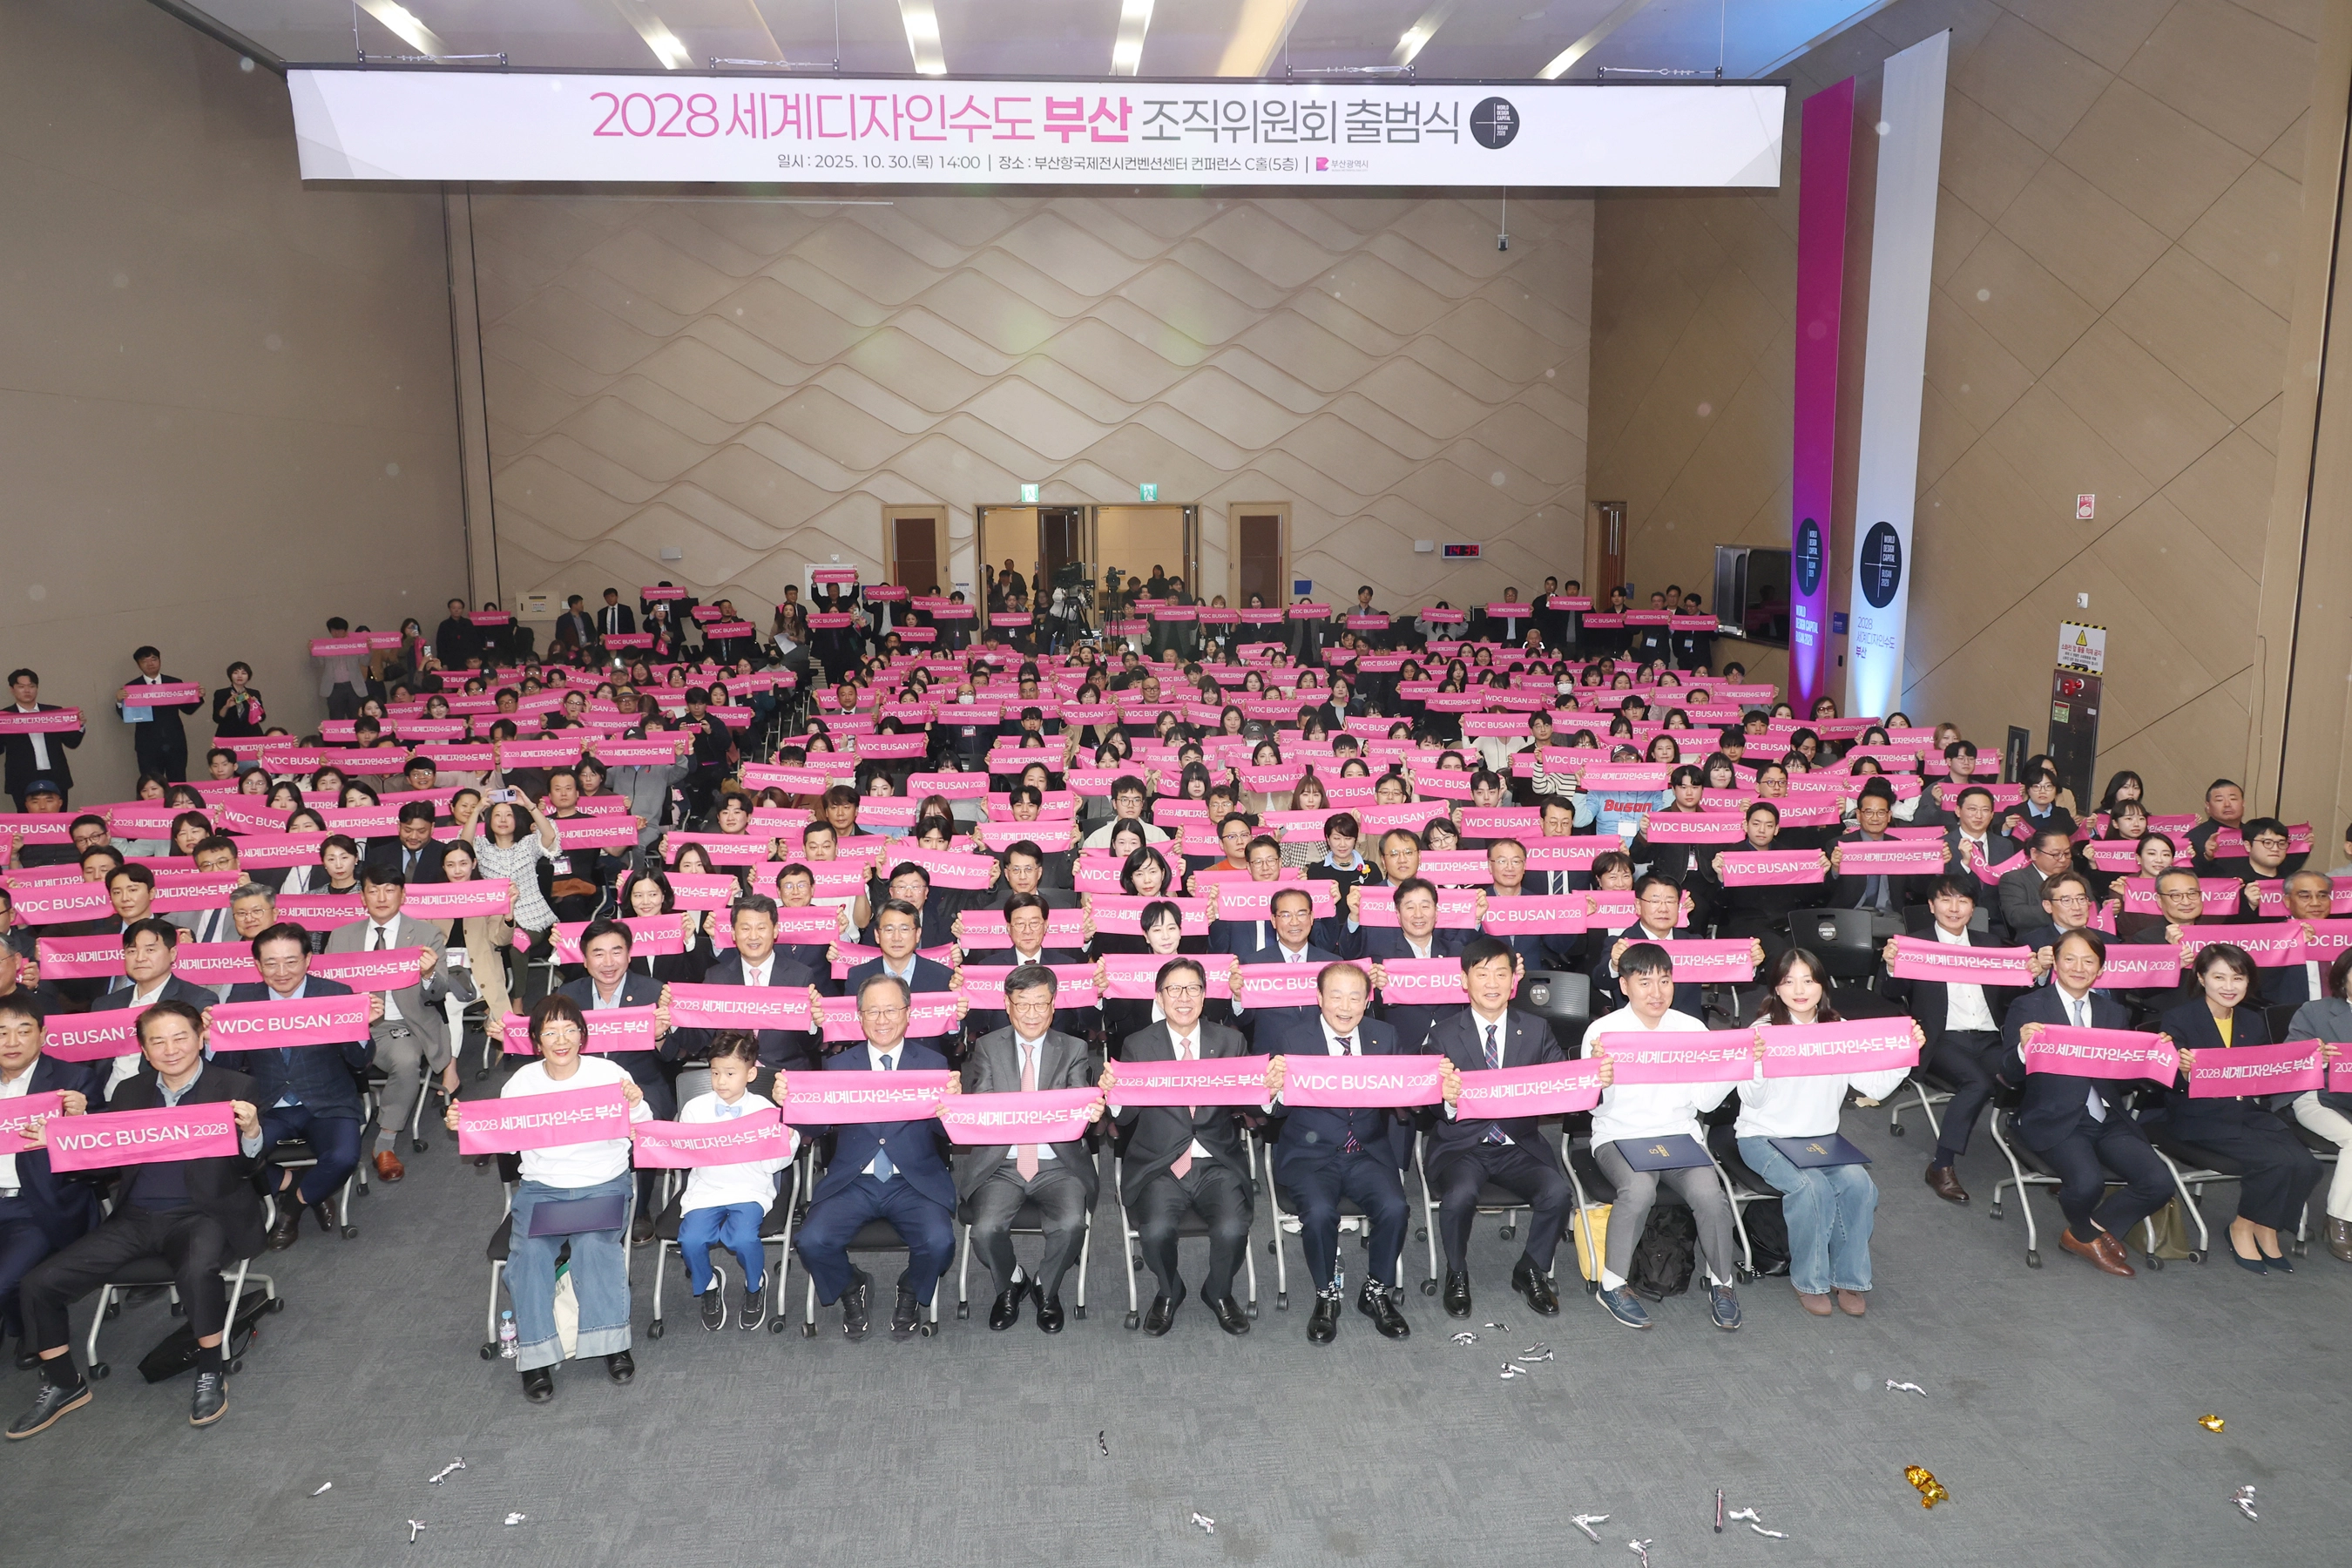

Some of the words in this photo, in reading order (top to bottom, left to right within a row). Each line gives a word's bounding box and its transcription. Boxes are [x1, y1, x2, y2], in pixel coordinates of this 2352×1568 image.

[590, 91, 720, 138] 2028
[726, 92, 1035, 143] 세계디자인수도
[1044, 97, 1131, 144] 부산
[1142, 99, 1336, 144] 조직위원회
[1345, 99, 1458, 145] 출범식
[814, 155, 858, 168] 2025.
[939, 155, 981, 169] 14:00
[1034, 157, 1187, 172] 부산항국제전시컨벤션센터
[1191, 157, 1241, 171] 컨퍼런스
[1245, 157, 1299, 172] C홀(5층)
[1331, 159, 1369, 168] 부산광역시
[1857, 616, 1873, 630] 2028
[1856, 631, 1896, 649] 세계디자인수도
[1855, 645, 1867, 659] 부산
[745, 772, 761, 781] 2028
[761, 774, 809, 784] 세계디자인수도
[809, 776, 825, 785] 부산
[911, 781, 935, 789] WDC
[1604, 799, 1652, 813] Busan
[1362, 814, 1387, 824] WDC
[1388, 812, 1425, 825] BUSAN
[1426, 807, 1444, 818] 2028
[1465, 818, 1492, 827] WDC
[1495, 818, 1531, 828] BUSAN
[565, 828, 618, 838] 세계디자인수도
[618, 826, 633, 835] 부산
[1650, 822, 1679, 832] WDC
[1681, 823, 1720, 832] BUSAN
[2173, 824, 2190, 833] 부산
[1000, 832, 1054, 841] 세계디자인수도
[1054, 831, 1070, 841] 부산
[1862, 852, 1922, 862] 세계디자인수도
[1923, 851, 1941, 861] 부산
[1725, 863, 1755, 874] WDC
[1757, 862, 1798, 873] BUSAN
[2213, 891, 2236, 901] 2028
[322, 963, 398, 979] 세계디자인수도
[399, 959, 420, 972] 부산
[1897, 952, 1923, 962] 2028
[1924, 954, 2002, 969] 세계디자인수도
[2002, 959, 2025, 970] 부산
[672, 1000, 700, 1010] 2028
[701, 1000, 781, 1015] 세계디자인수도
[782, 1003, 808, 1014] 부산
[216, 1018, 264, 1033] WDC
[268, 1014, 330, 1031] BUSAN
[335, 1012, 363, 1024] 2028
[1767, 1045, 1796, 1057] 2028
[1798, 1037, 1884, 1057] 세계디자인수도
[1884, 1035, 1910, 1051] 부산
[1635, 1050, 1720, 1064] 세계디자인수도
[1721, 1047, 1747, 1061] 부산
[2031, 1043, 2055, 1054] 2028
[2055, 1044, 2146, 1062] 세계디자인수도
[2146, 1050, 2173, 1067] 부산
[2195, 1068, 2220, 1078] 2028
[2220, 1061, 2293, 1079] 세계디자인수도
[2293, 1056, 2315, 1071] 부산
[1115, 1078, 1144, 1086] 2028
[1145, 1075, 1236, 1087] 세계디자인수도
[1238, 1074, 1266, 1086] 부산
[1292, 1074, 1337, 1090] WDC
[1342, 1075, 1403, 1090] BUSAN
[1407, 1074, 1437, 1086] 2028
[1459, 1087, 1488, 1099] 2028
[1489, 1078, 1578, 1098] 세계디자인수도
[789, 1092, 821, 1103] 2028
[822, 1089, 916, 1104] 세계디자인수도
[916, 1087, 944, 1101] 부산
[466, 1119, 498, 1132] 2028
[500, 1107, 594, 1130] 세계디자인수도
[595, 1103, 623, 1119] 부산
[944, 1112, 976, 1124] 2028
[977, 1110, 1068, 1125] 세계디자인수도
[56, 1132, 112, 1151] WDC
[116, 1125, 189, 1146] BUSAN
[193, 1123, 228, 1137] 2028
[671, 1131, 758, 1150] 세계디자인수도
[758, 1123, 782, 1139] 부산
